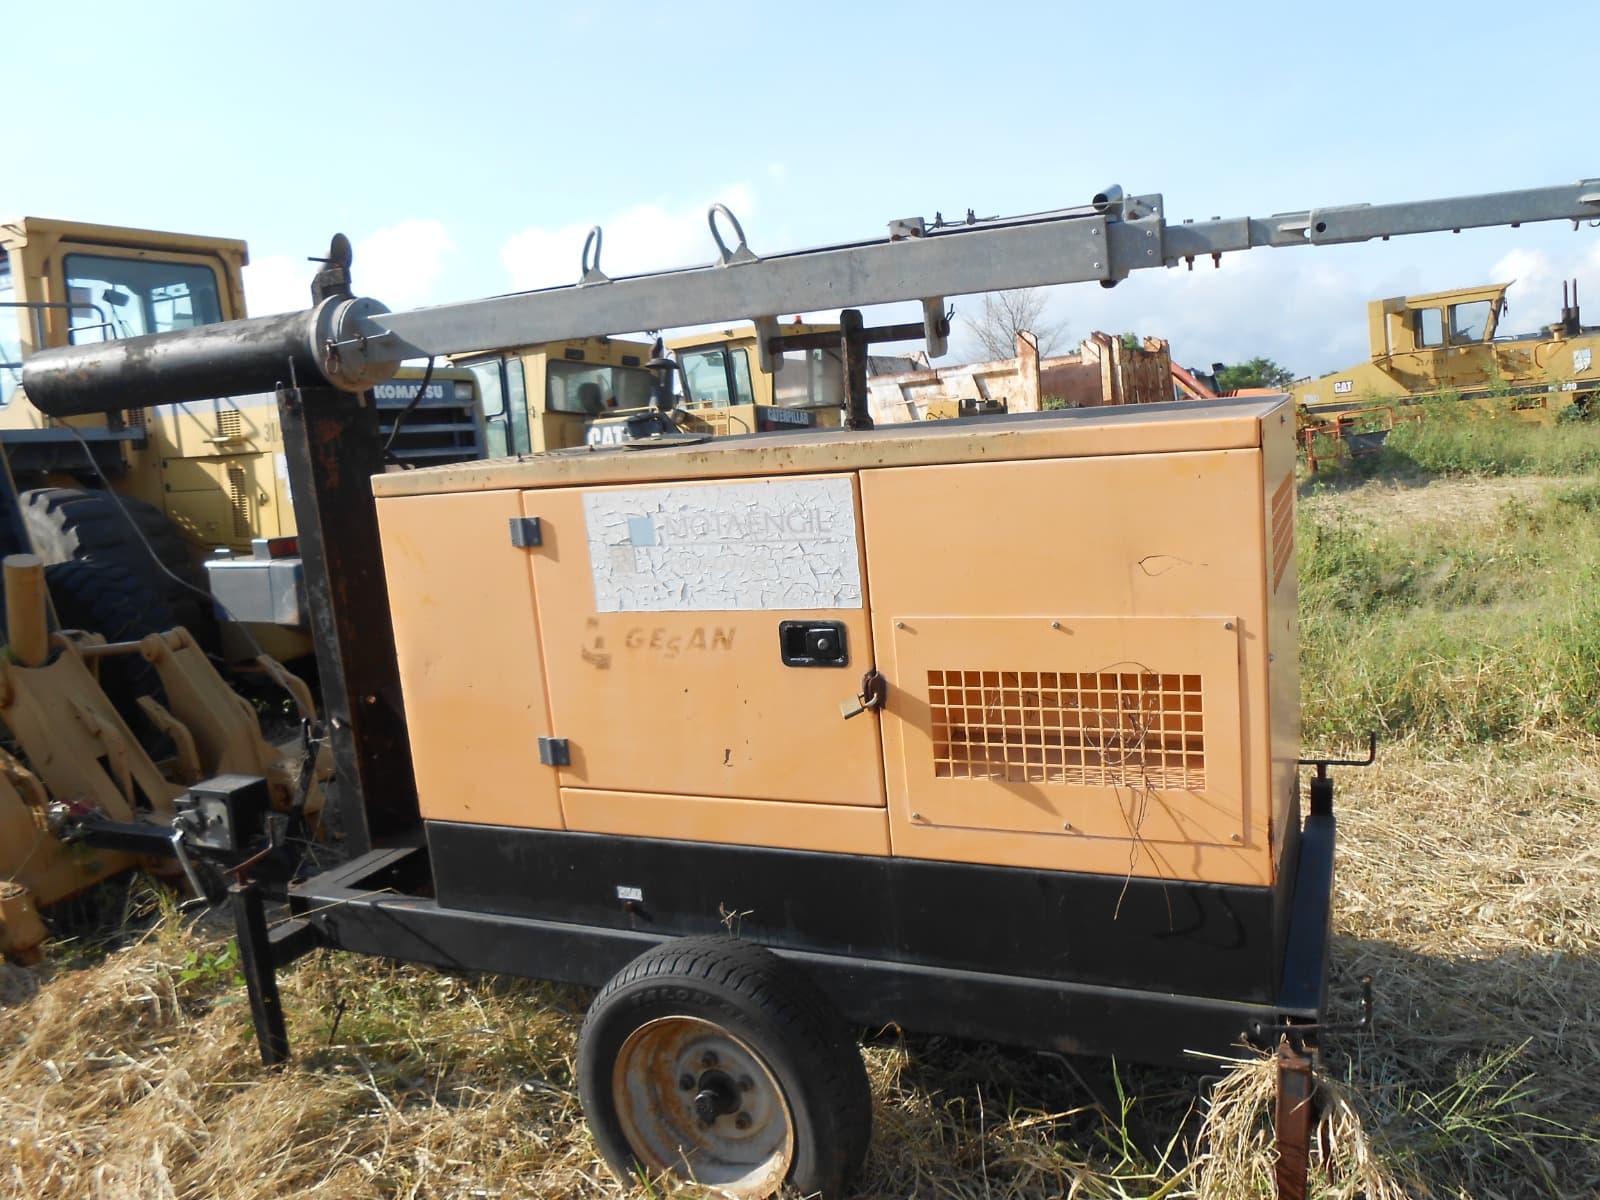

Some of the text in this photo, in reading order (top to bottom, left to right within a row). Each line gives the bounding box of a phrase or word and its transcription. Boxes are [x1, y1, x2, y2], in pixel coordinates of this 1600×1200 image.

[1335, 381, 1353, 393] CAT
[767, 407, 809, 425] CATERPILLAR
[587, 425, 625, 446] CAT
[625, 626, 736, 659] GESAN
